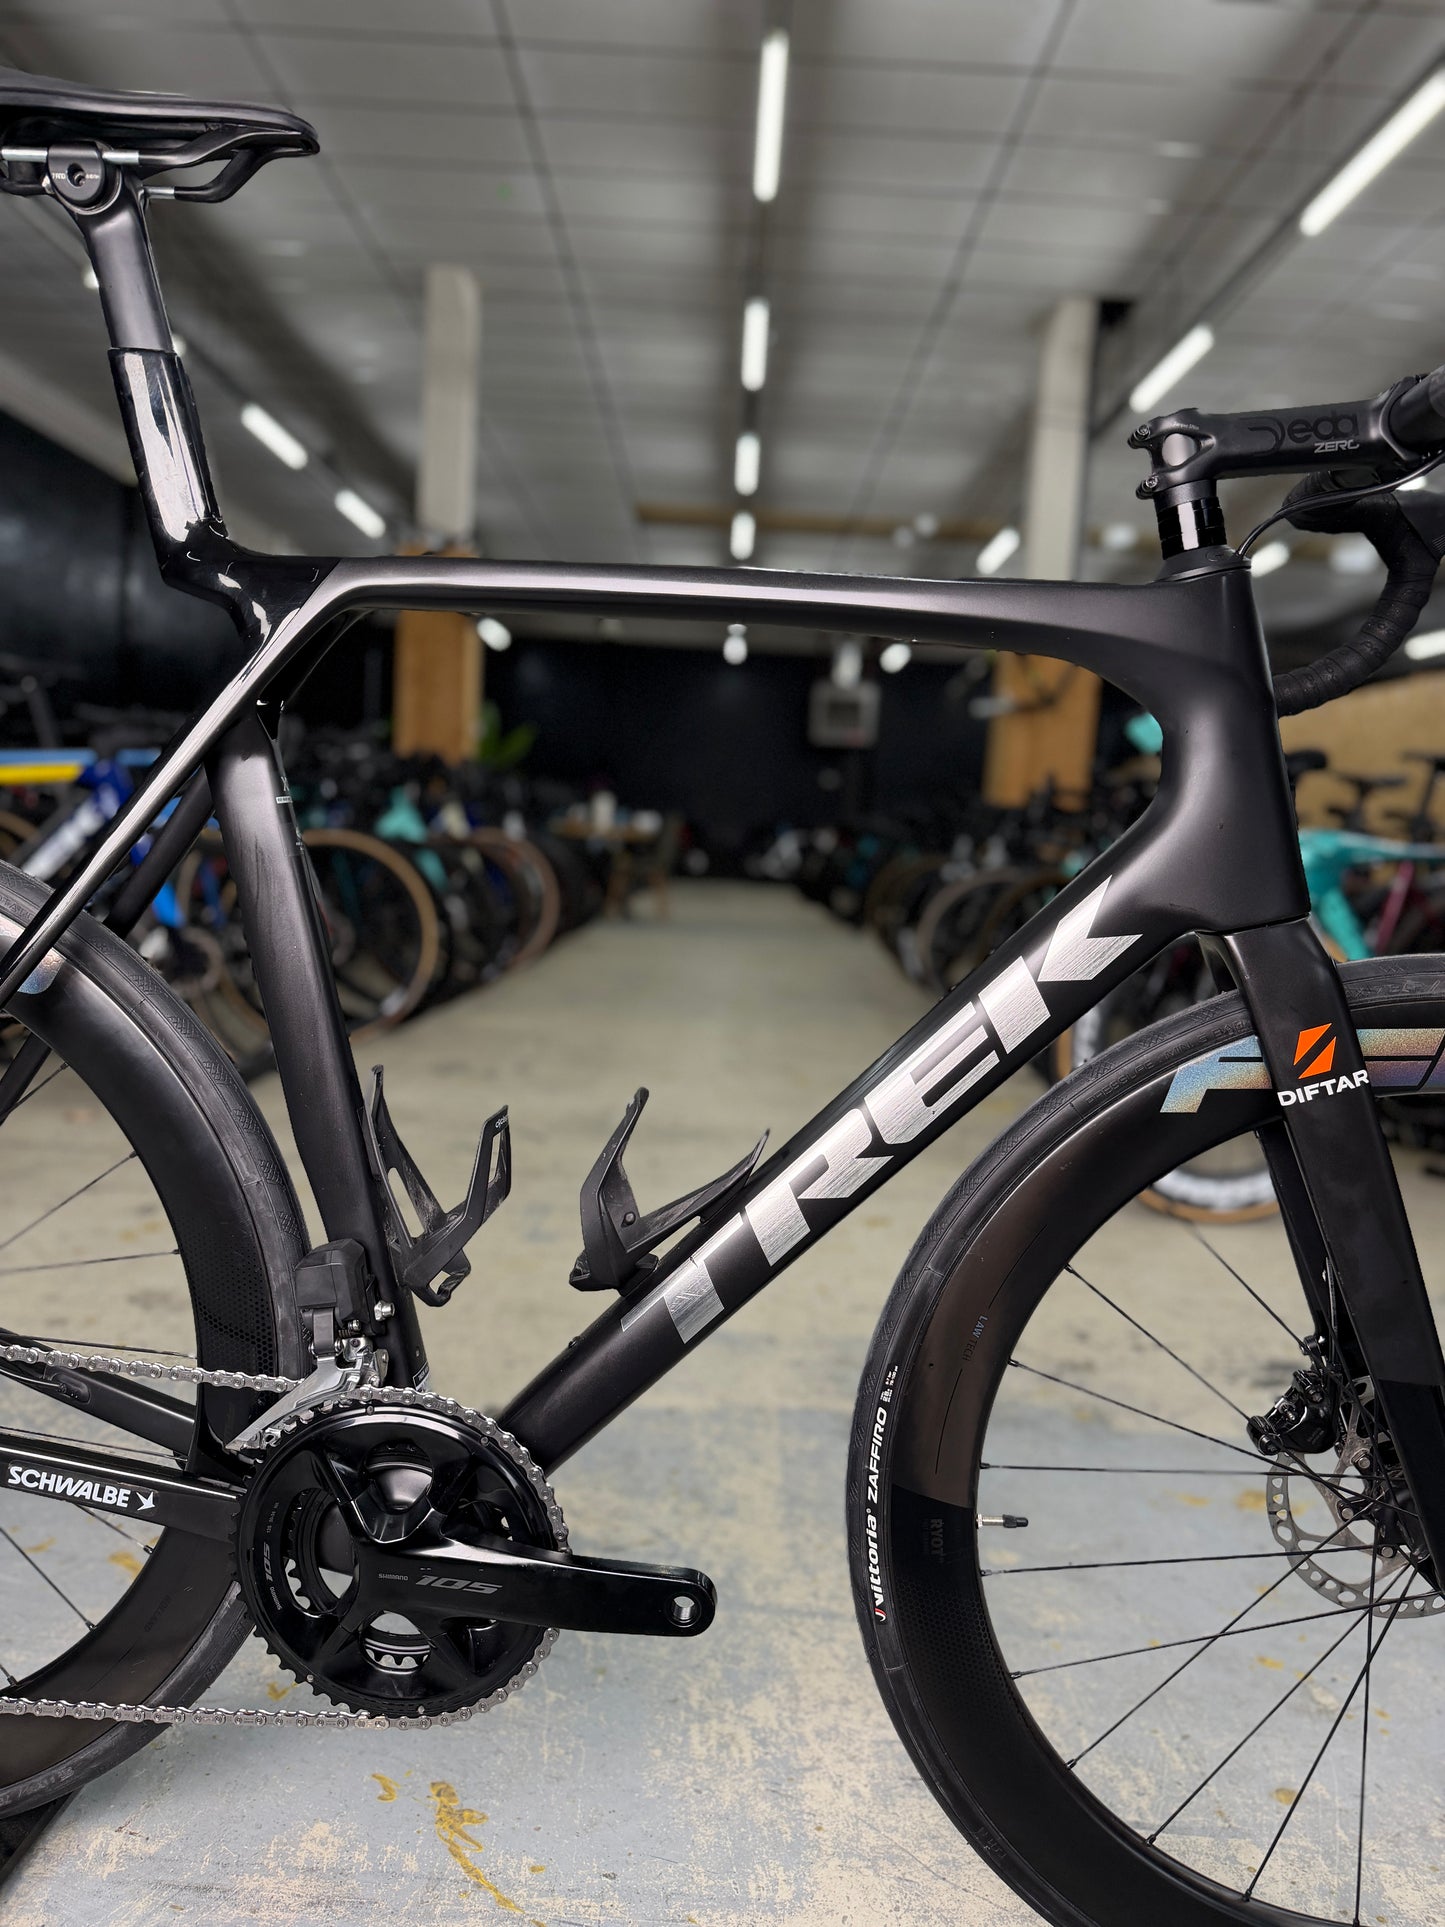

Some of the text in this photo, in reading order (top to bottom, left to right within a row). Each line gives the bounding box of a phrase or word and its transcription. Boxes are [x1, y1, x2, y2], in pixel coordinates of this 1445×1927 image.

[1277, 1069, 1370, 1106] DIFTAR
[621, 875, 1142, 1344] TREK
[868, 1406, 887, 1504] ZAFFIRO
[8, 1466, 131, 1508] SCHWALBE
[415, 1574, 503, 1595] 105
